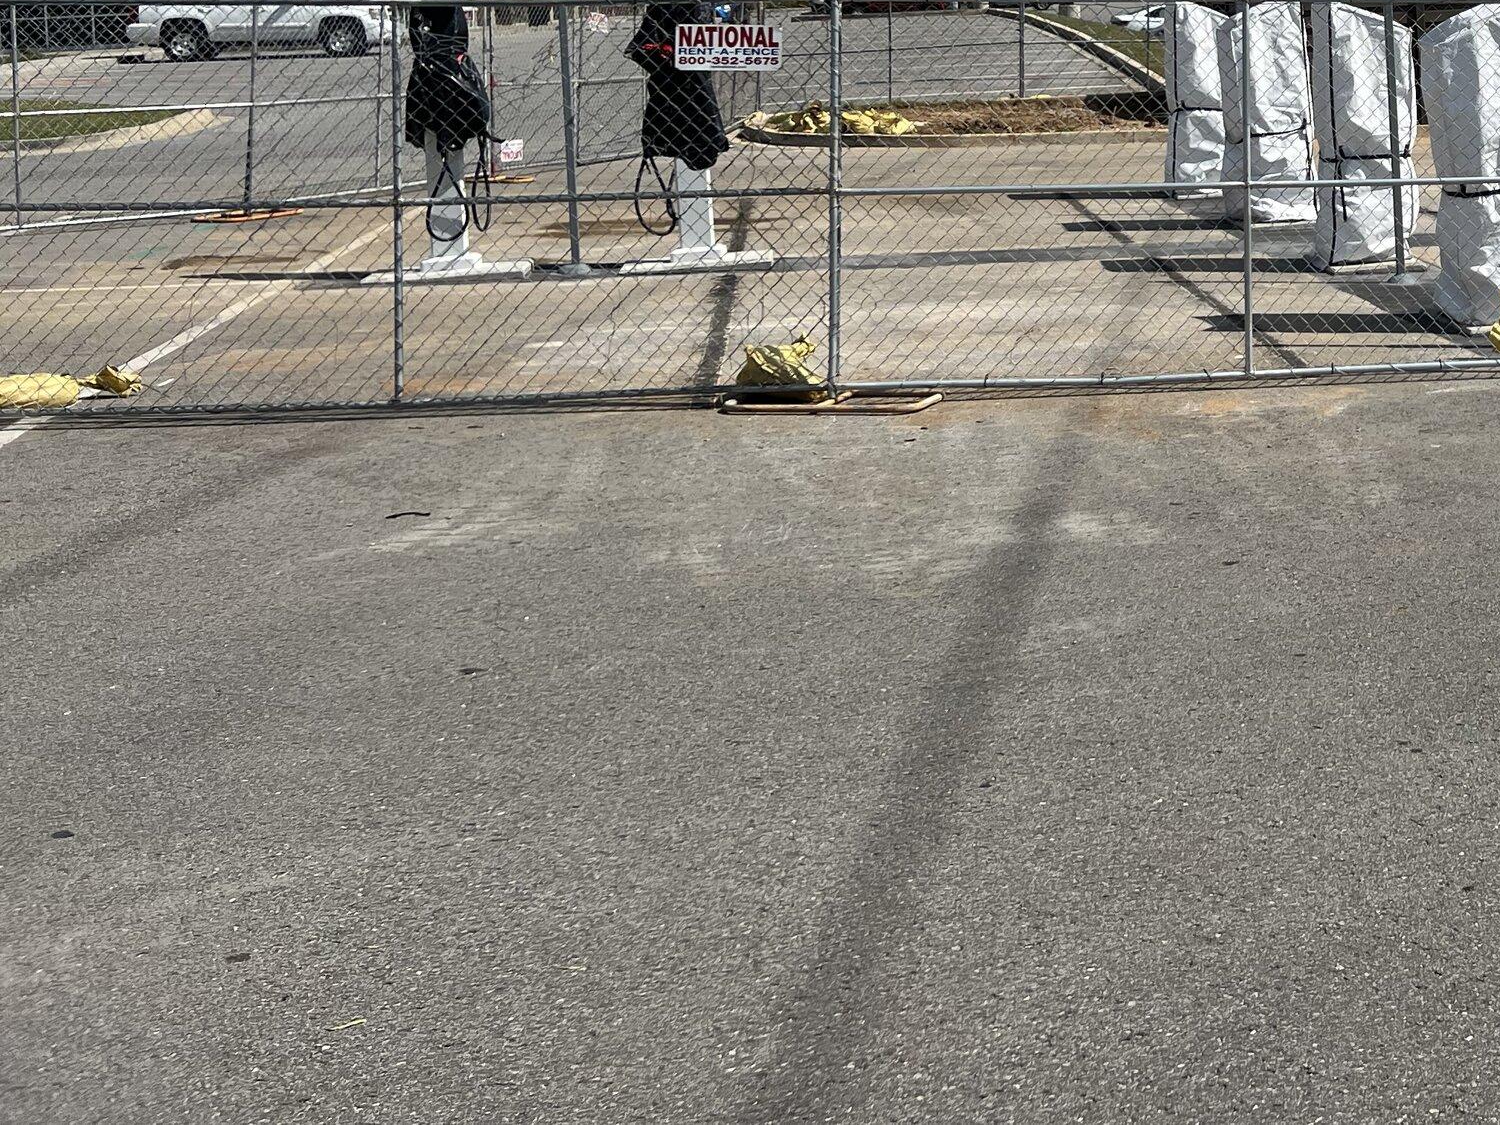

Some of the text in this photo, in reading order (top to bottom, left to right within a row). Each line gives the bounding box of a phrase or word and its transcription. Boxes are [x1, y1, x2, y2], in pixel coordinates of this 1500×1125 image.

[678, 26, 779, 48] NATIONAL
[678, 47, 780, 56] RENT-A-FENCE
[678, 56, 779, 65] 800-352-5675
